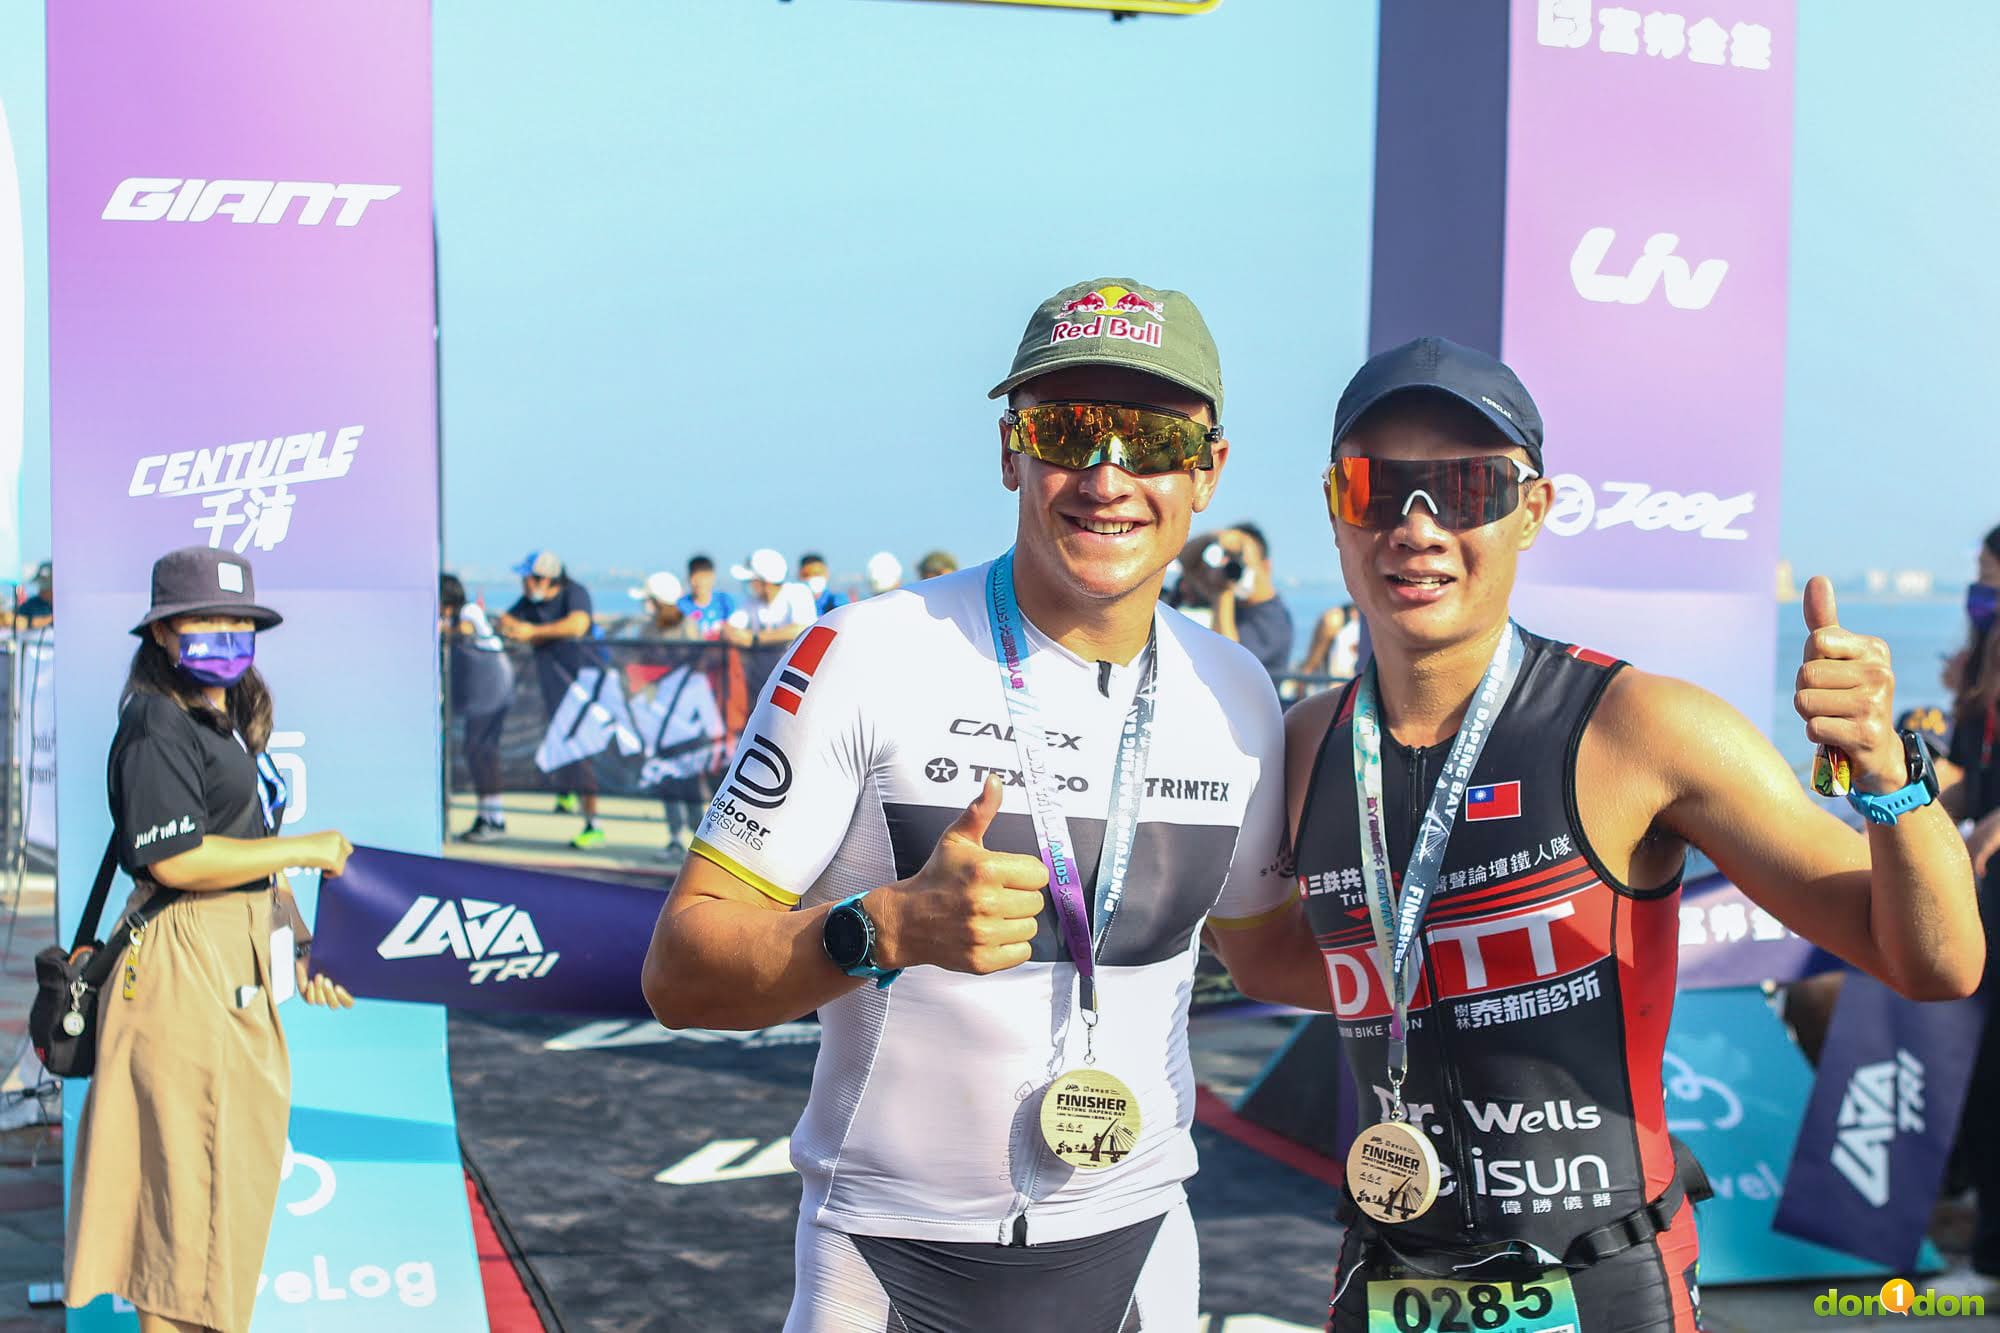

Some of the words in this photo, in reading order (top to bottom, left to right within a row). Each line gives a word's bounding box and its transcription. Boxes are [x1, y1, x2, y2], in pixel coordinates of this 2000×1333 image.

[101, 177, 402, 226] GIANT
[1051, 316, 1103, 345] Red
[1107, 317, 1162, 348] Bull
[128, 425, 364, 497] CENTUPLE
[949, 718, 1083, 750] CALEX
[1455, 707, 1490, 779] DAPENG
[969, 764, 1089, 792] TEXCO
[1145, 777, 1230, 802] TRIMTEX
[712, 793, 771, 838] deboer
[1444, 781, 1464, 818] BAY
[1309, 868, 1362, 896] 三鉄共
[1339, 891, 1364, 906] Tri
[377, 895, 544, 961] LAVA
[1393, 884, 1424, 974] FINISHER
[468, 952, 560, 985] TRI
[1470, 970, 1602, 1029] 泰新診所
[1355, 1024, 1383, 1038] BIKE
[1057, 1094, 1126, 1111] FINISHER
[1462, 1100, 1601, 1134] Wells
[1831, 1060, 1897, 1207] LAVA
[1362, 1144, 1420, 1171] FINISHER
[1501, 1192, 1612, 1215] 偉勝儀器
[1393, 1280, 1553, 1333] 0285
